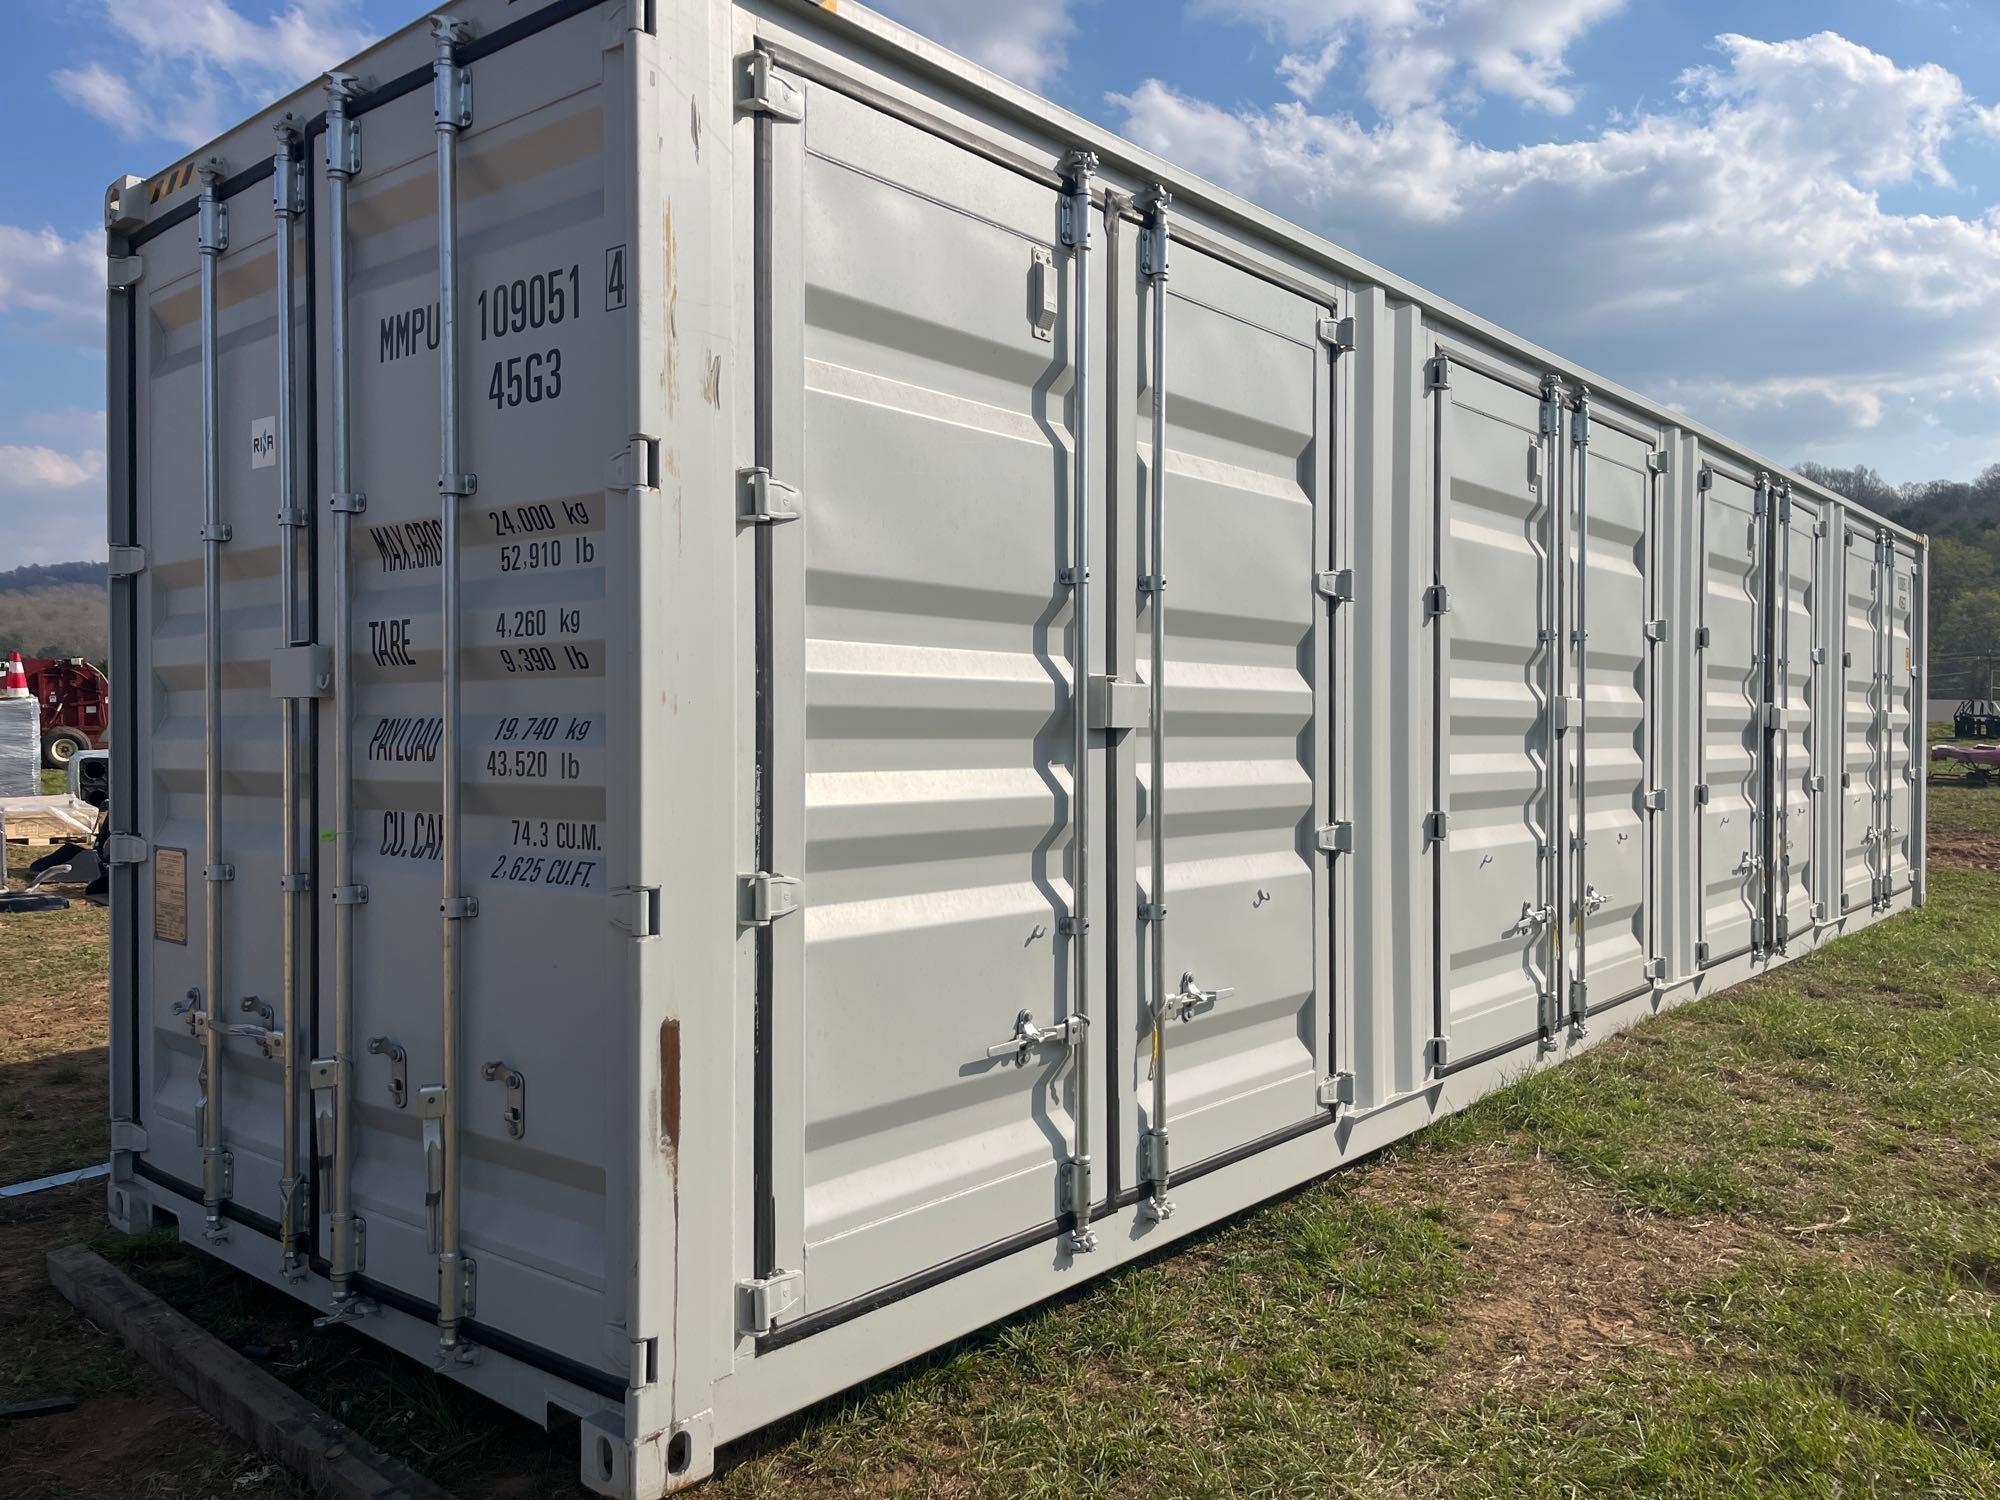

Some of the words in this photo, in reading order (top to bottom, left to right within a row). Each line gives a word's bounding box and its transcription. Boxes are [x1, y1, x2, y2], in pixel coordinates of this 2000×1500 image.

[380, 302, 441, 363] MMPU
[478, 264, 580, 341] 109051
[608, 250, 625, 304] 4
[488, 348, 562, 410] 45G3
[489, 504, 556, 537] 24,000
[561, 500, 590, 525] kg
[500, 540, 561, 572] 52,910
[575, 536, 595, 564] lb
[368, 618, 417, 667] TARE
[495, 609, 546, 638] 4,260
[559, 607, 581, 634] kg
[500, 646, 557, 673] 9,390
[563, 645, 590, 670] lb
[368, 718, 443, 762] PAYLOAD
[494, 716, 560, 741] 19,740
[564, 717, 592, 742] kg
[486, 750, 547, 778] 43,520
[561, 751, 580, 780] lb
[511, 819, 549, 848] 74.3
[555, 821, 602, 852] CU.M.
[490, 854, 544, 883] 2,625
[545, 858, 597, 889] CU.FT.
